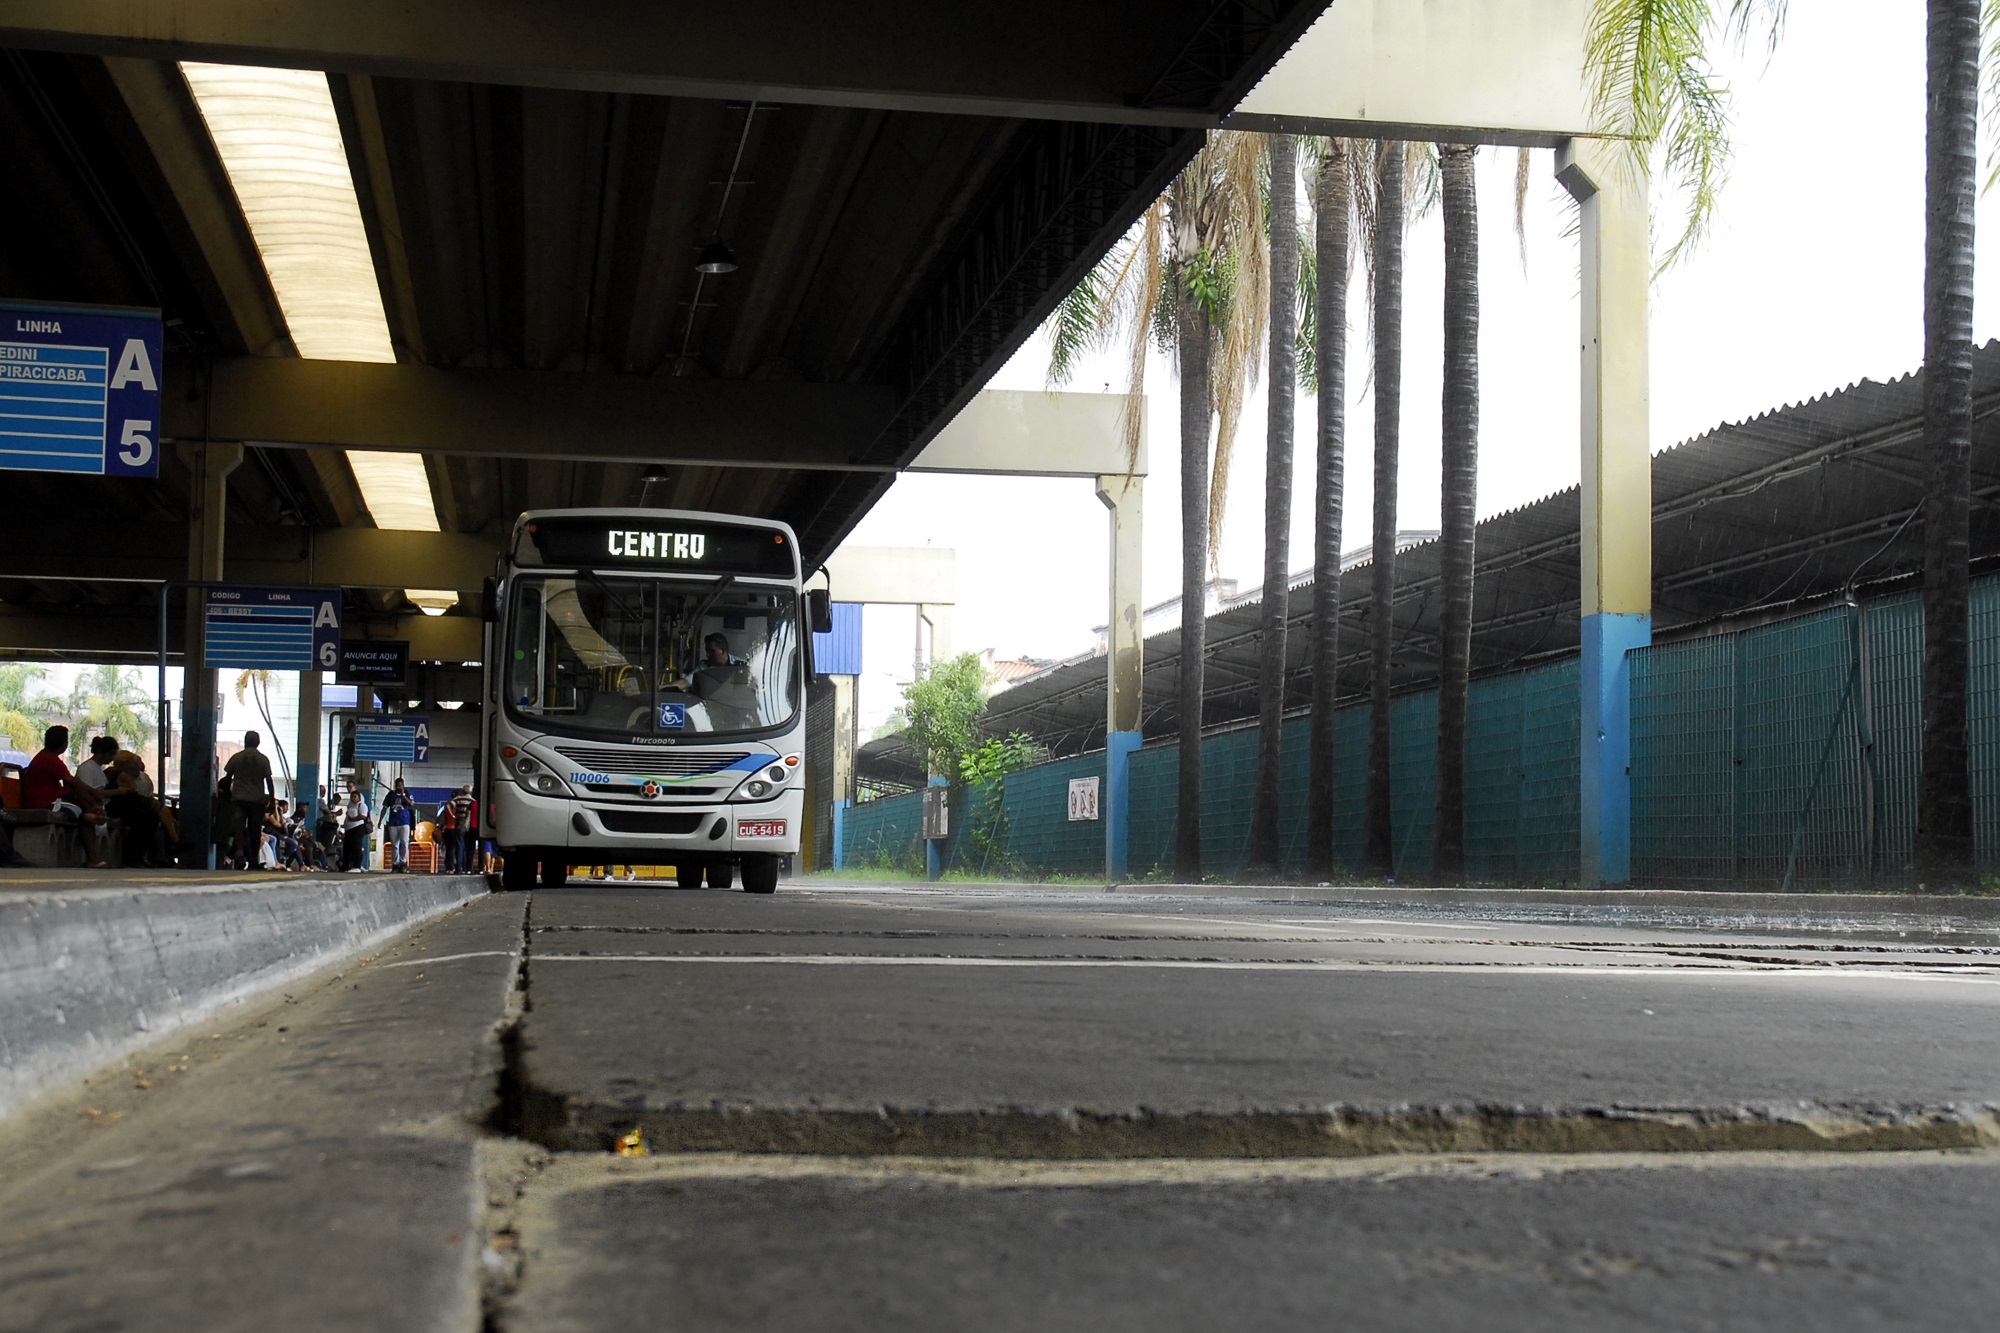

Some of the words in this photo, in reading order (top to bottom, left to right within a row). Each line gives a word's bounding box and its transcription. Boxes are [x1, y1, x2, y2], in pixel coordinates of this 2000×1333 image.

[17, 320, 62, 334] LINHA
[0, 347, 37, 361] EDINI
[110, 339, 158, 391] A
[0, 365, 87, 382] PIRACICABA
[118, 419, 153, 467] 5
[608, 530, 705, 559] CENTRO
[211, 591, 241, 600] CÓDIGO
[268, 593, 291, 601] LINHA
[315, 601, 339, 628] A
[319, 642, 337, 667] 6
[344, 651, 378, 660] ANUNCIE
[378, 652, 398, 661] AQUI
[415, 723, 429, 739] A
[631, 736, 676, 745] Marcopolo
[417, 746, 428, 760] 7
[570, 772, 610, 784] 110006
